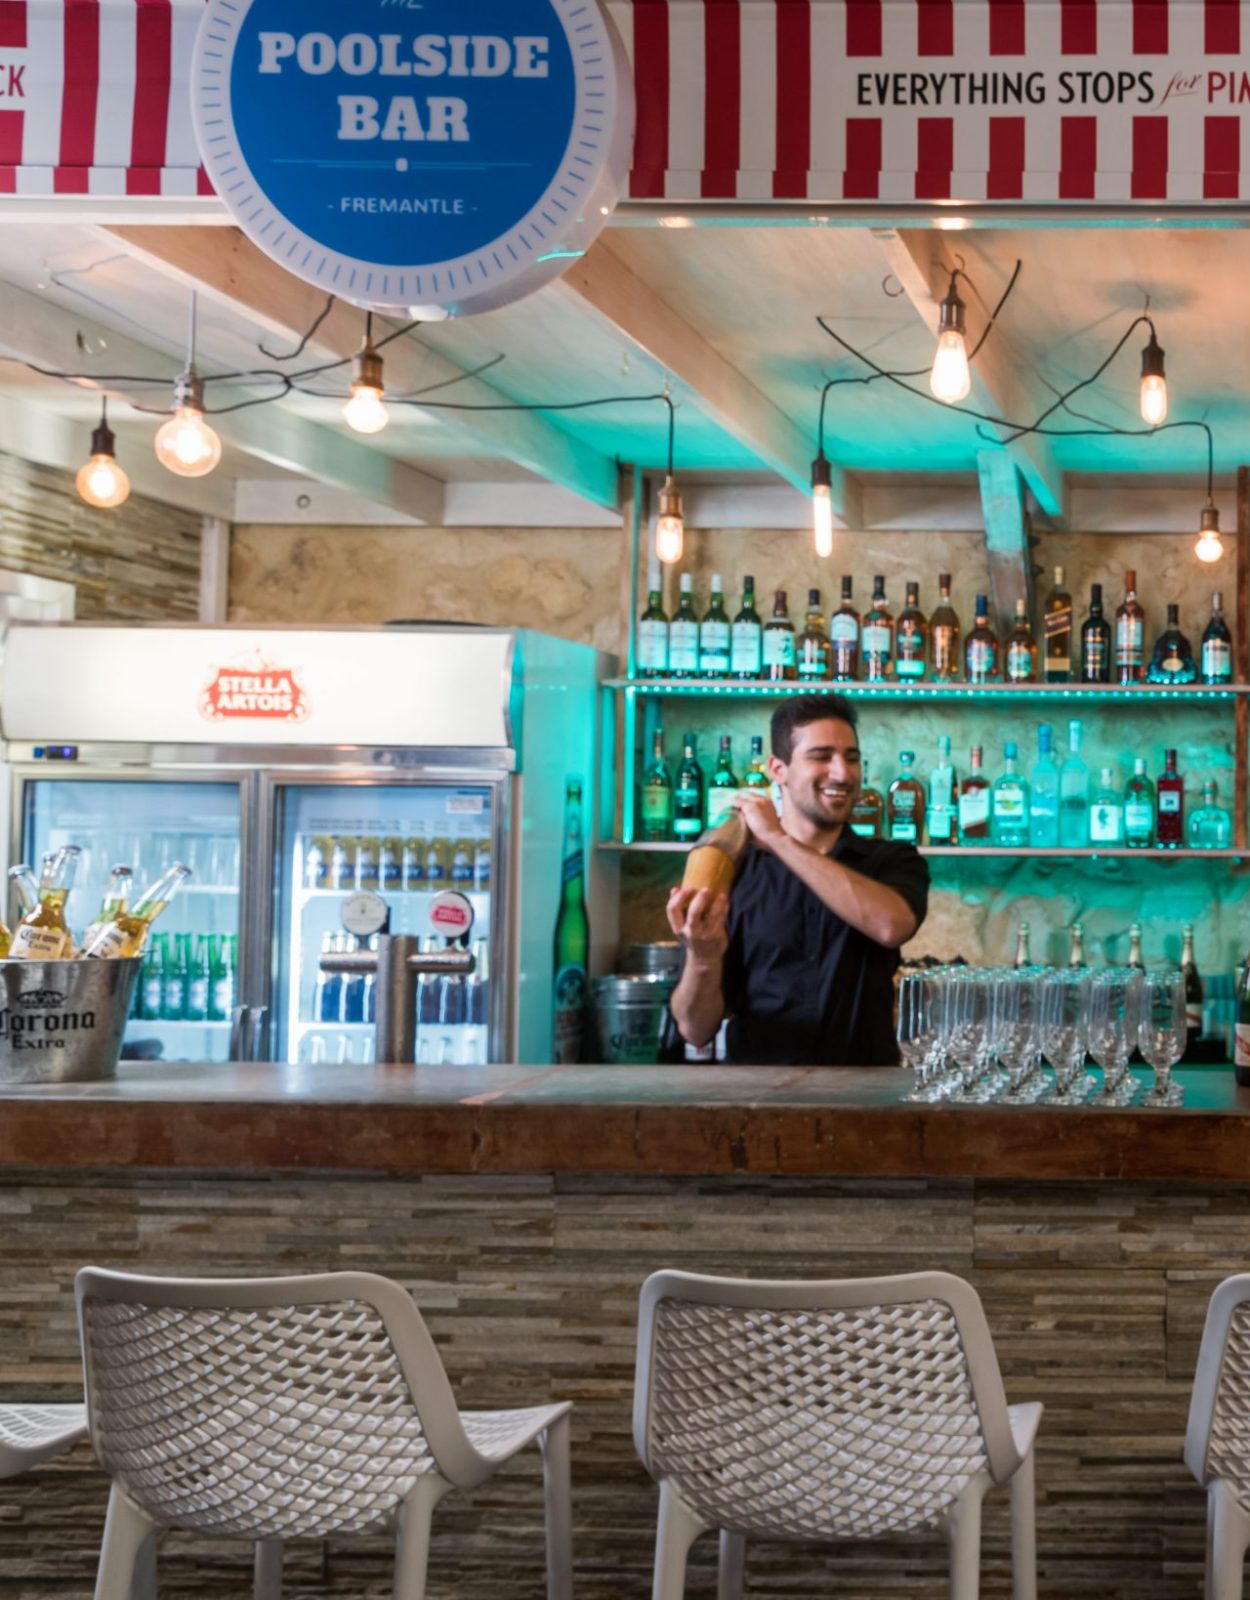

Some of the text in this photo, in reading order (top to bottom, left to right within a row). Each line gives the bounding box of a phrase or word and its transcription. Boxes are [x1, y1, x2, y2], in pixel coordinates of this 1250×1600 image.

[258, 32, 549, 78] POOLSIDE
[0, 64, 26, 97] K
[857, 71, 1046, 105] EVERYTHING
[1058, 70, 1154, 104] STOPS
[1150, 69, 1203, 110] for
[337, 95, 470, 141] BAR
[340, 197, 465, 215] FREMANTLE
[218, 676, 291, 694] STELLA
[216, 692, 293, 711] ARTOIS
[12, 1034, 65, 1049] Extra
